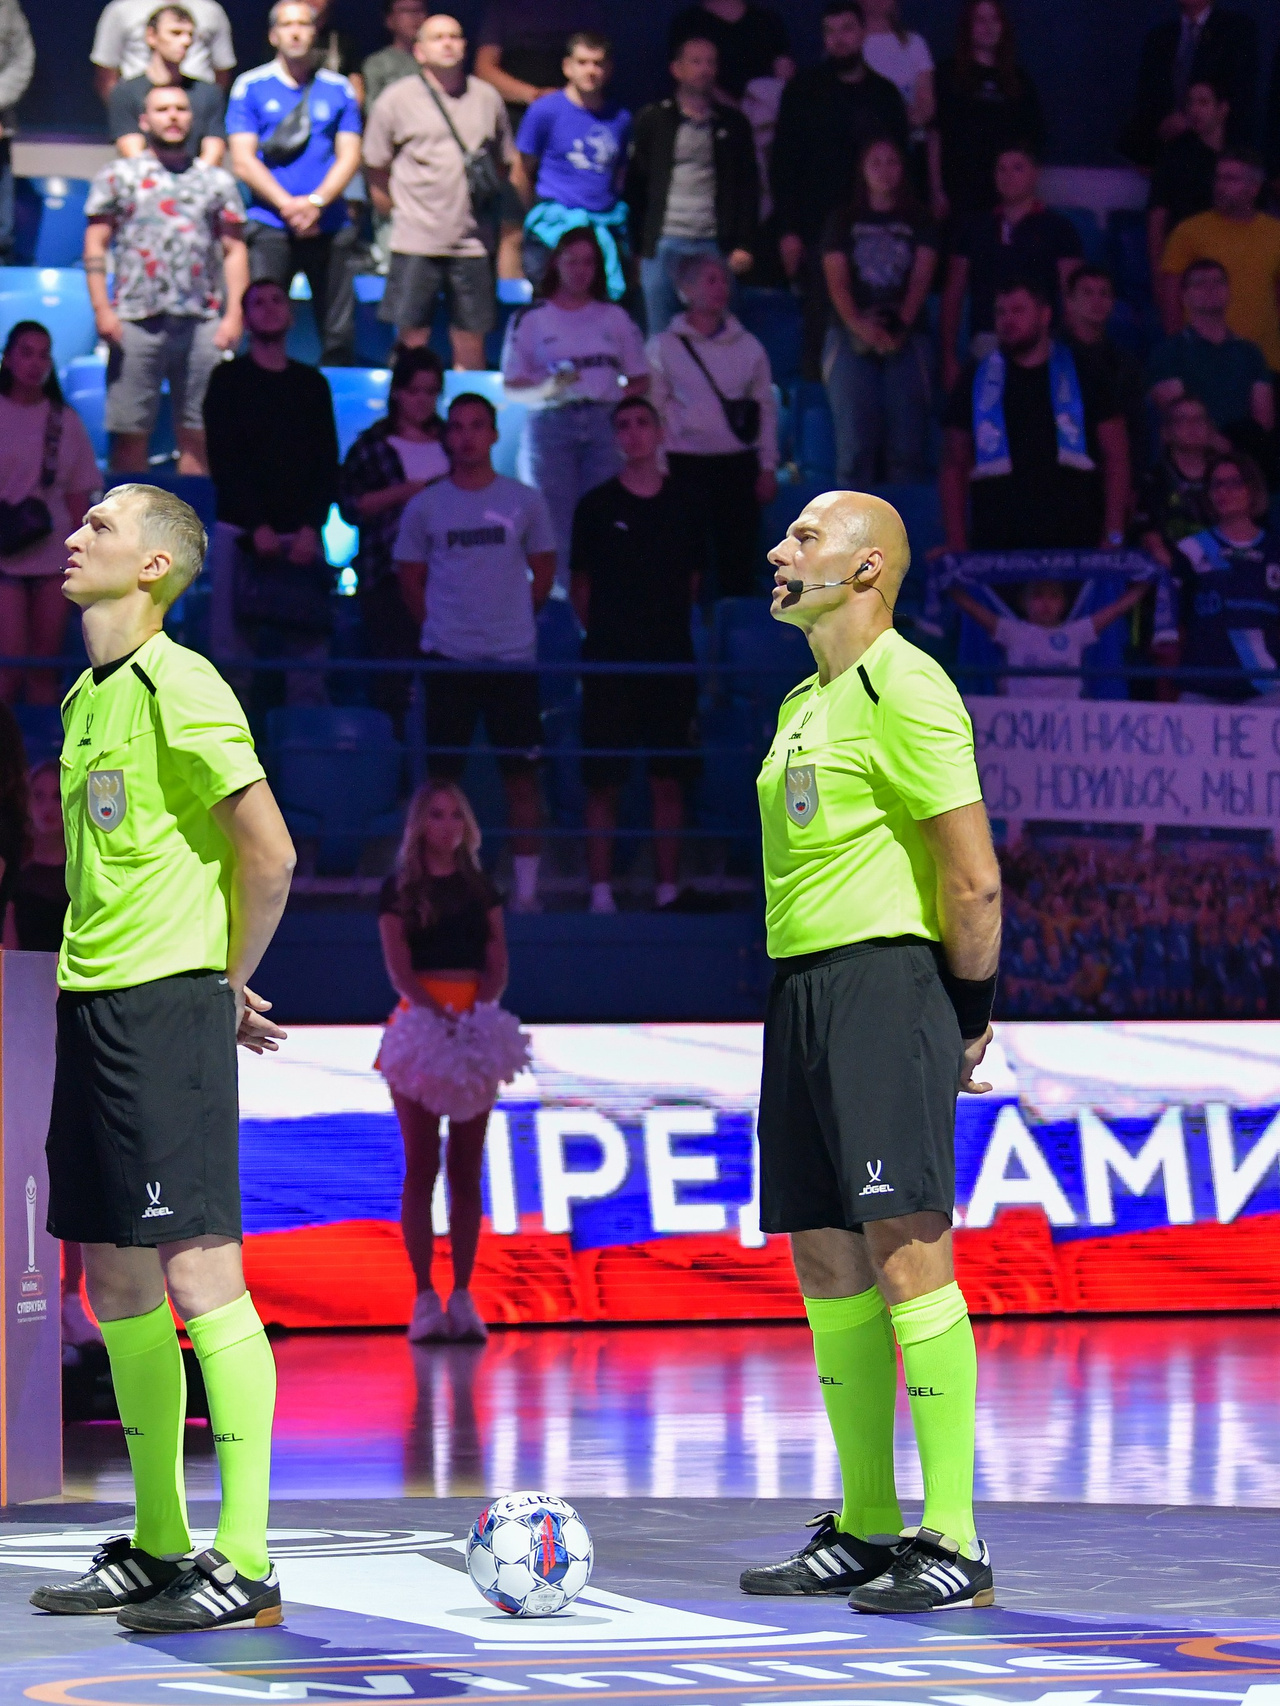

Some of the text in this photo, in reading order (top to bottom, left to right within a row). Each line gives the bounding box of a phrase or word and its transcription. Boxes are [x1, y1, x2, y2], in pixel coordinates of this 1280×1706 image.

[1211, 713, 1258, 759] НЕ
[1202, 769, 1254, 816] МЫ
[157, 1654, 1161, 1700] Winline
